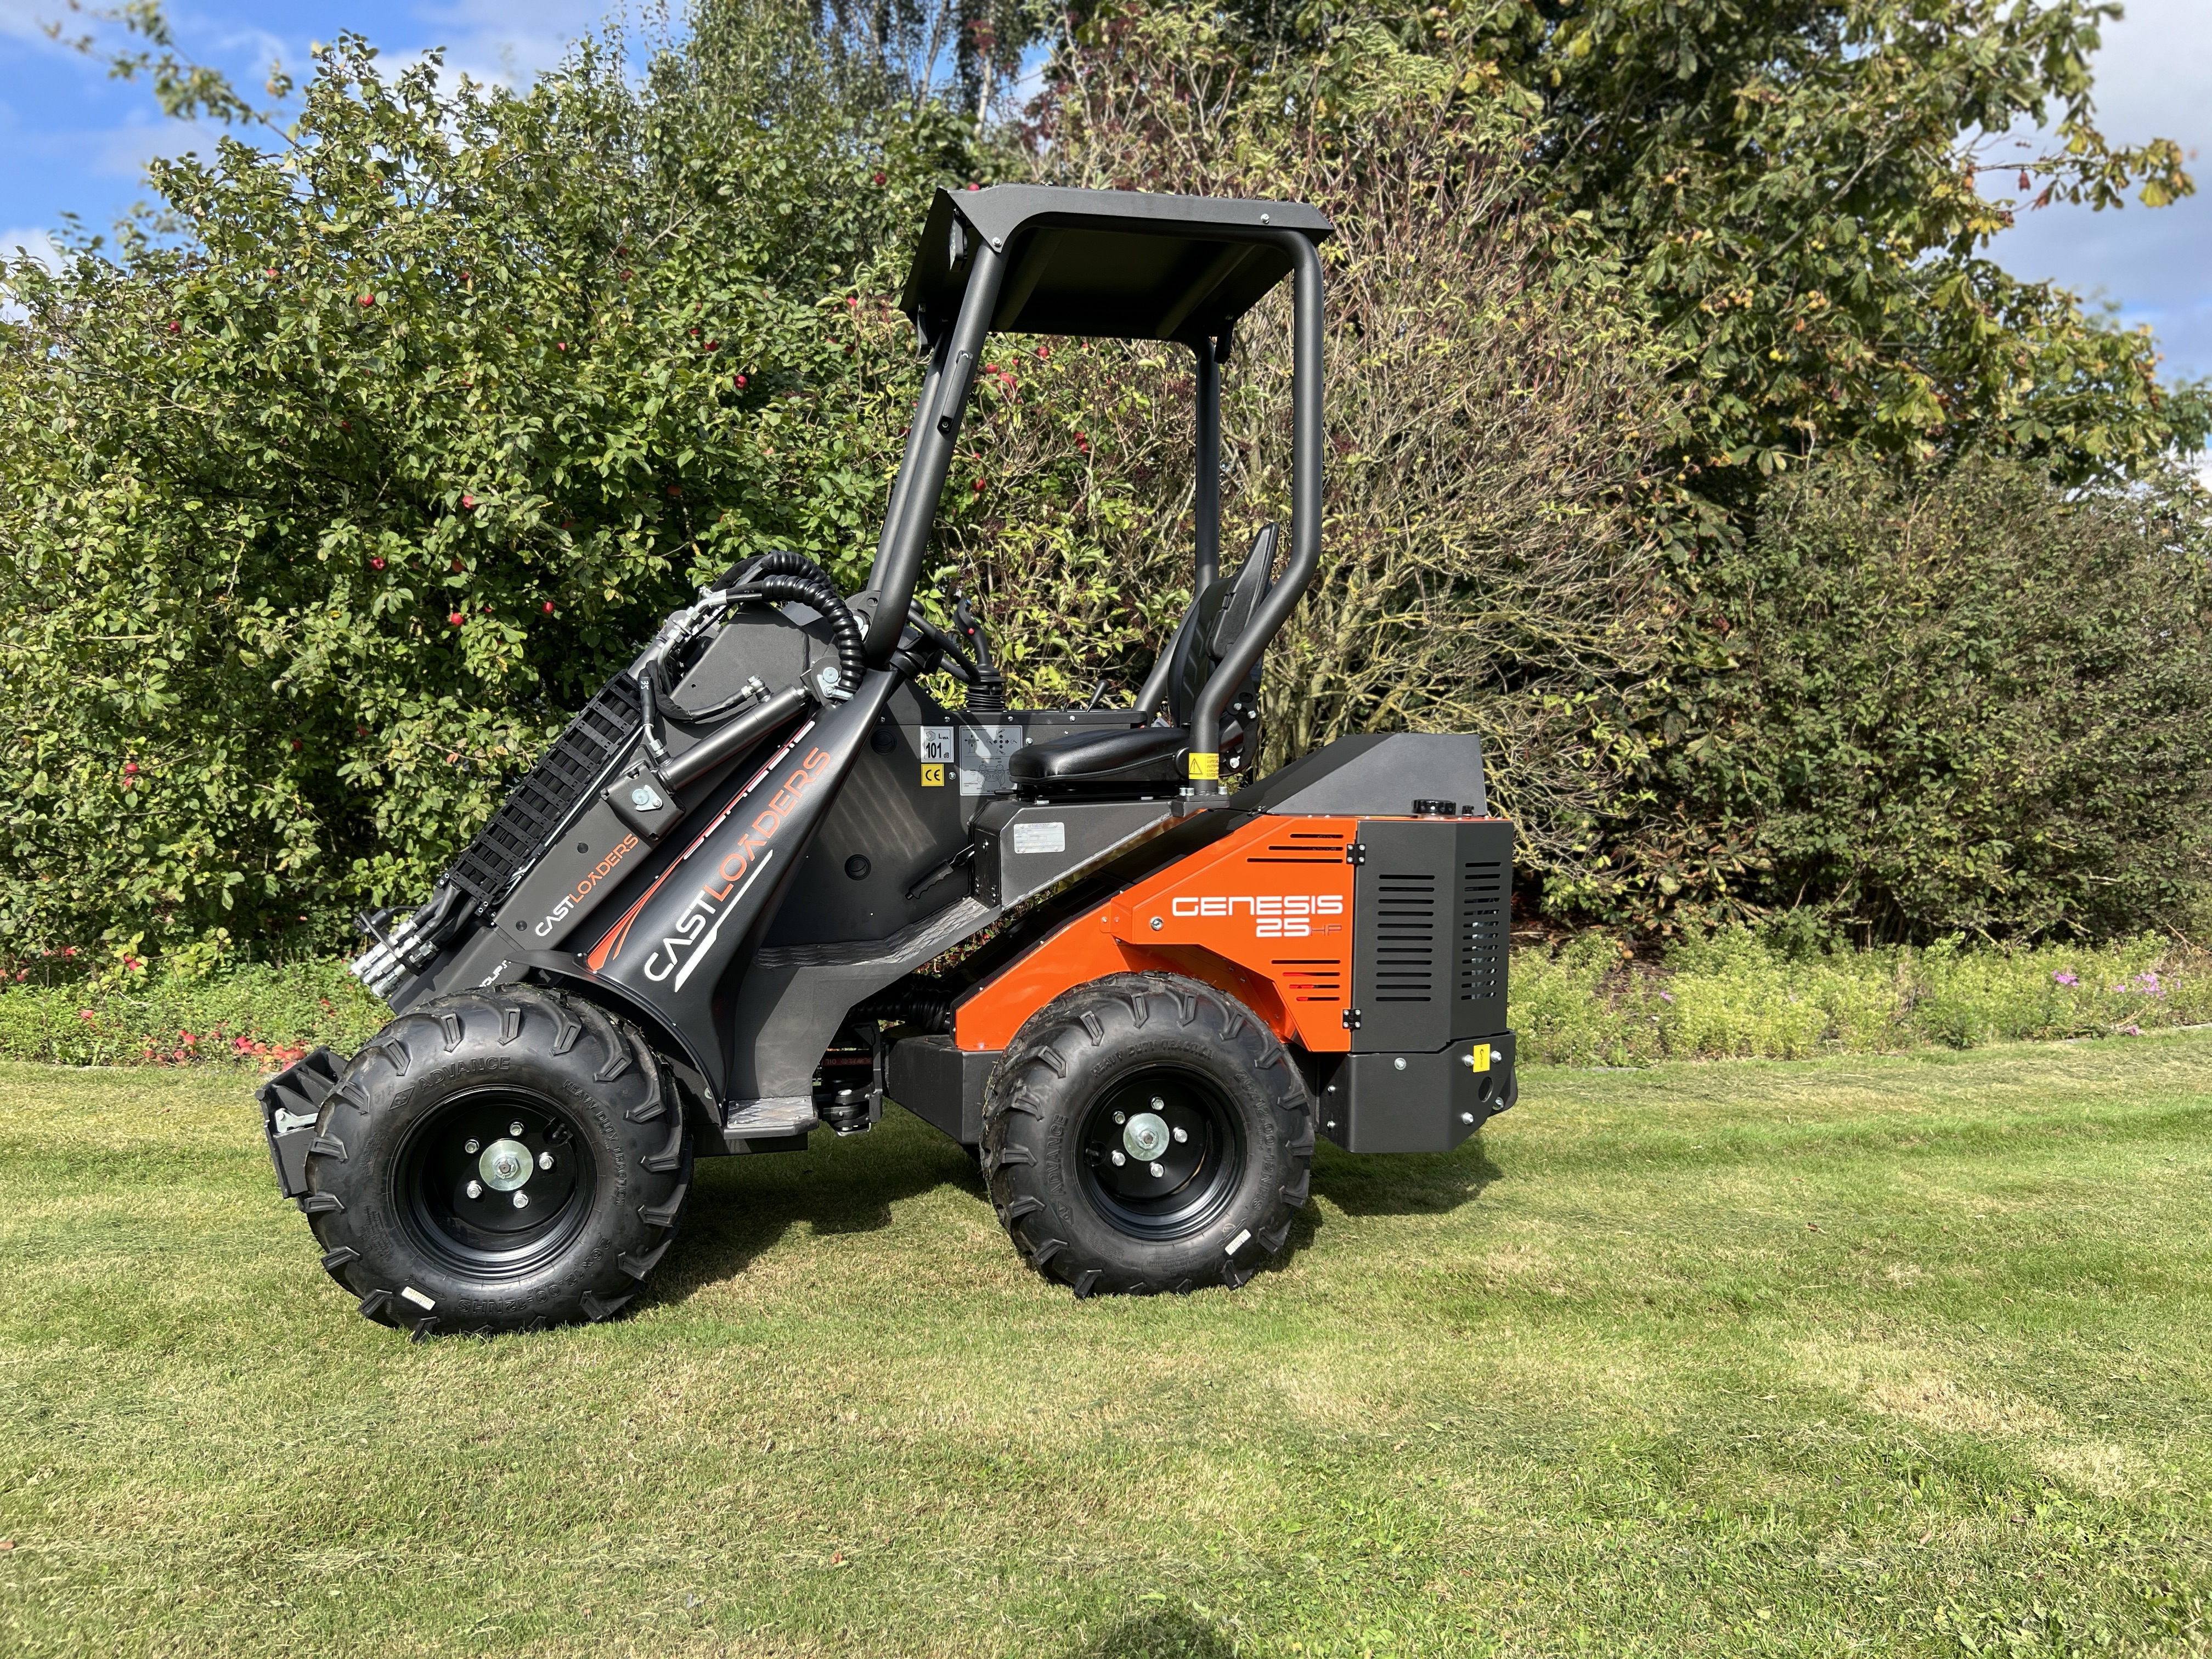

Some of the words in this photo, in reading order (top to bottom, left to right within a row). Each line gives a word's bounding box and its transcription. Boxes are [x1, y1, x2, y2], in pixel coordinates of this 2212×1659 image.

[926, 742, 941, 758] 101
[926, 769, 940, 781] CE
[1172, 895, 1343, 916] GENESIS
[419, 1057, 510, 1092] ADVANCE
[1091, 1050, 1124, 1077] HEAVY
[1127, 1039, 1157, 1056] DUTY
[562, 1079, 598, 1110] HEAVY
[596, 1110, 619, 1141] DUTY
[613, 1146, 627, 1207] TRACTION
[1046, 1114, 1068, 1196] ADVANCE
